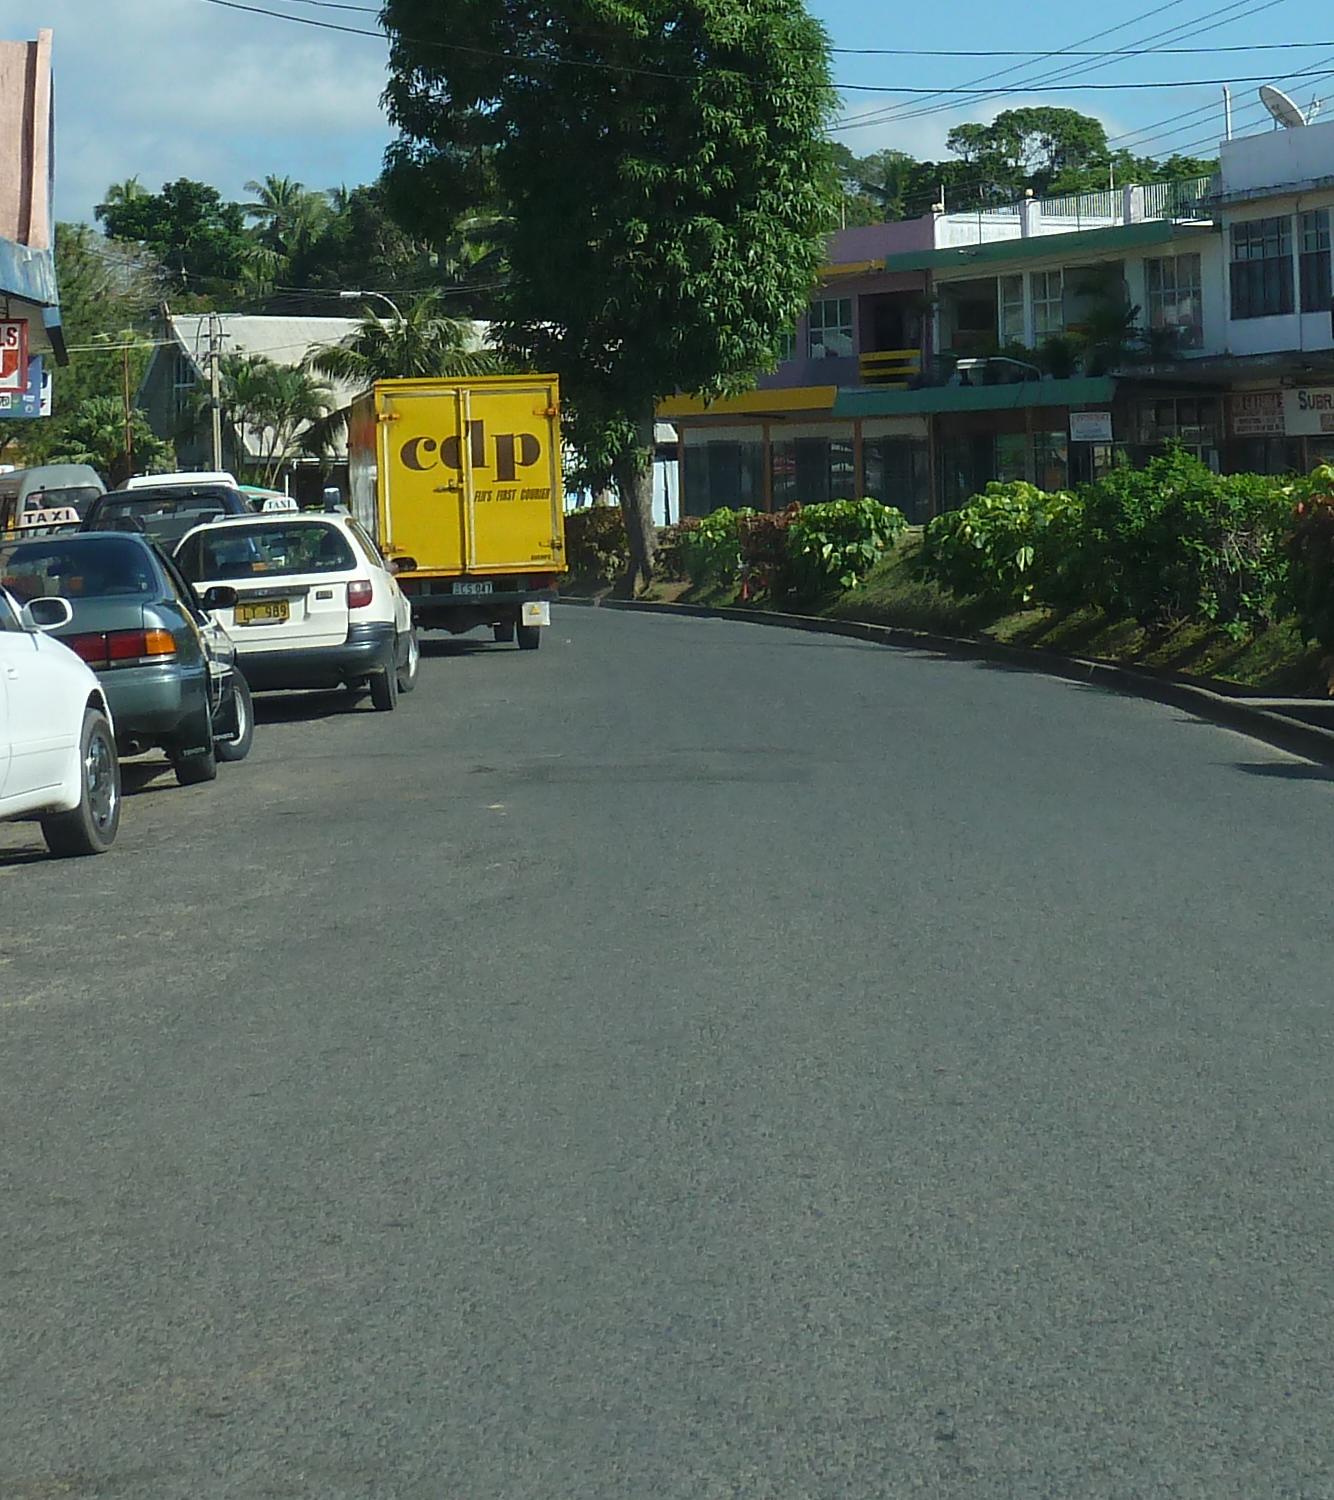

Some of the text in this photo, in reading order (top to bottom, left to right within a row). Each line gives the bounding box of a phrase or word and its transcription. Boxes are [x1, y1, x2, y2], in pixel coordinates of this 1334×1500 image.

[400, 419, 541, 483] cdp
[268, 500, 291, 509] TAXI
[24, 510, 70, 524] TAXI
[265, 603, 287, 618] 989
